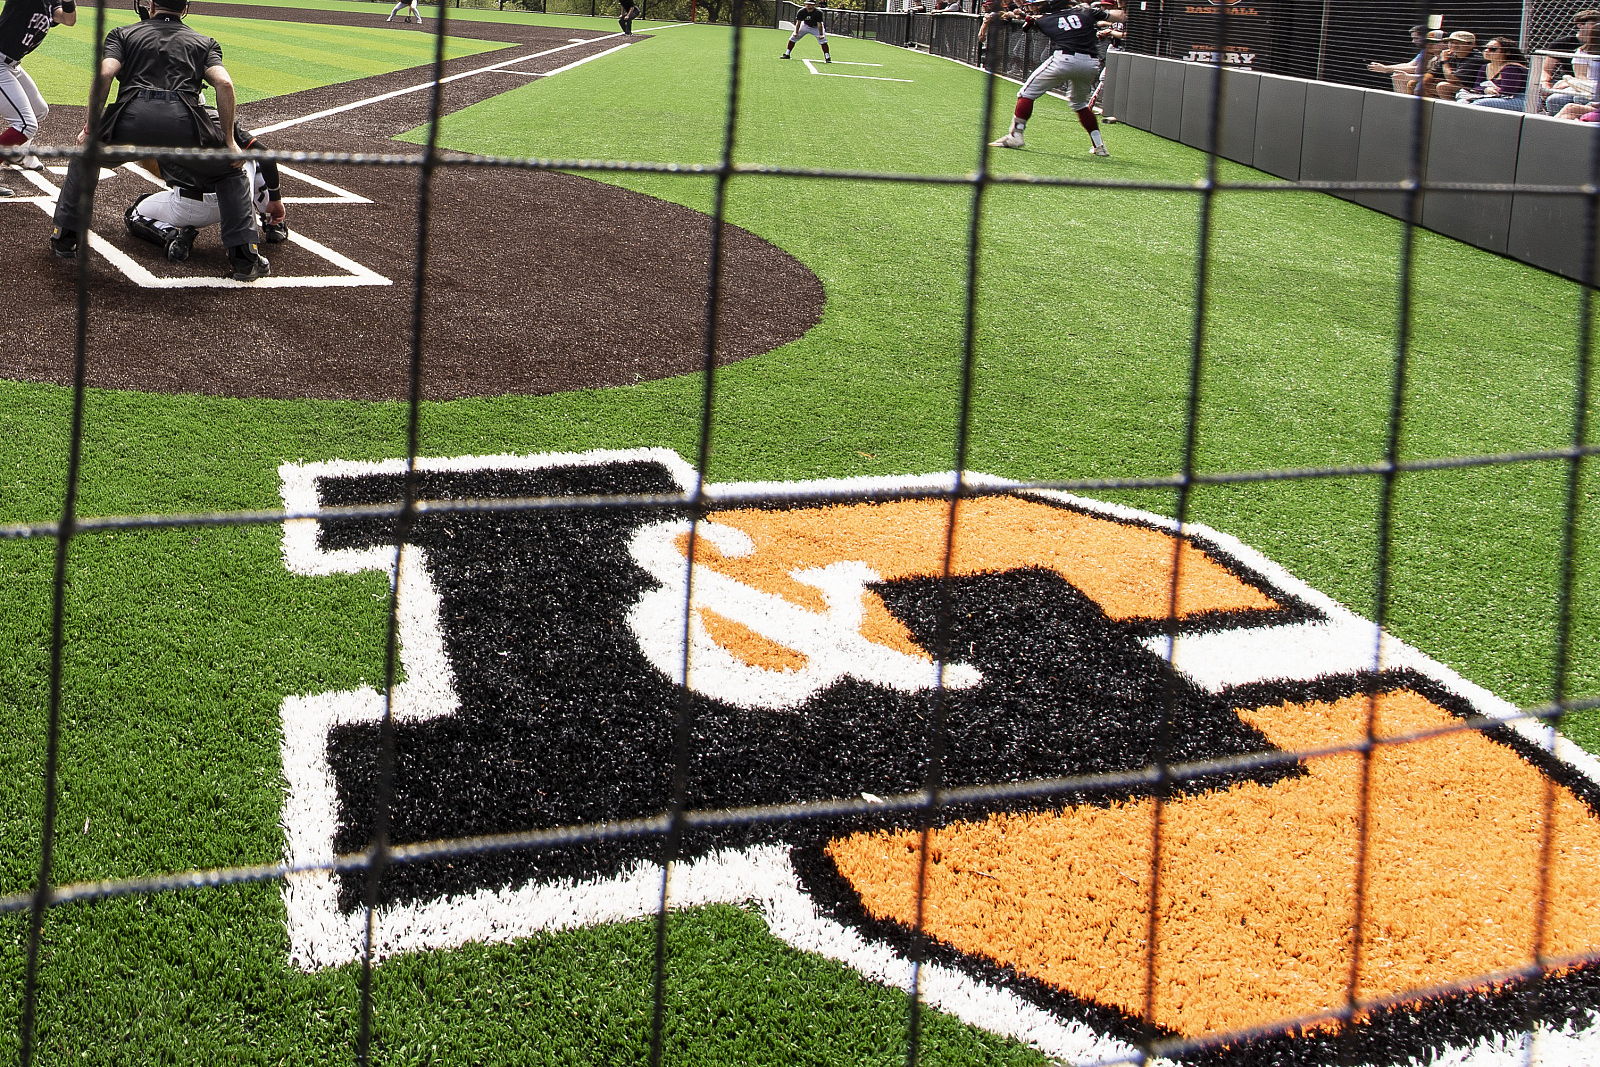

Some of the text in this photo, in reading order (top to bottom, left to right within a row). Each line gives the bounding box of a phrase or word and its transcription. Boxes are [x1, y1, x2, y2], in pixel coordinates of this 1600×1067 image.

[1057, 14, 1083, 31] 40
[21, 33, 34, 46] 17
[1182, 51, 1256, 64] JERRY
